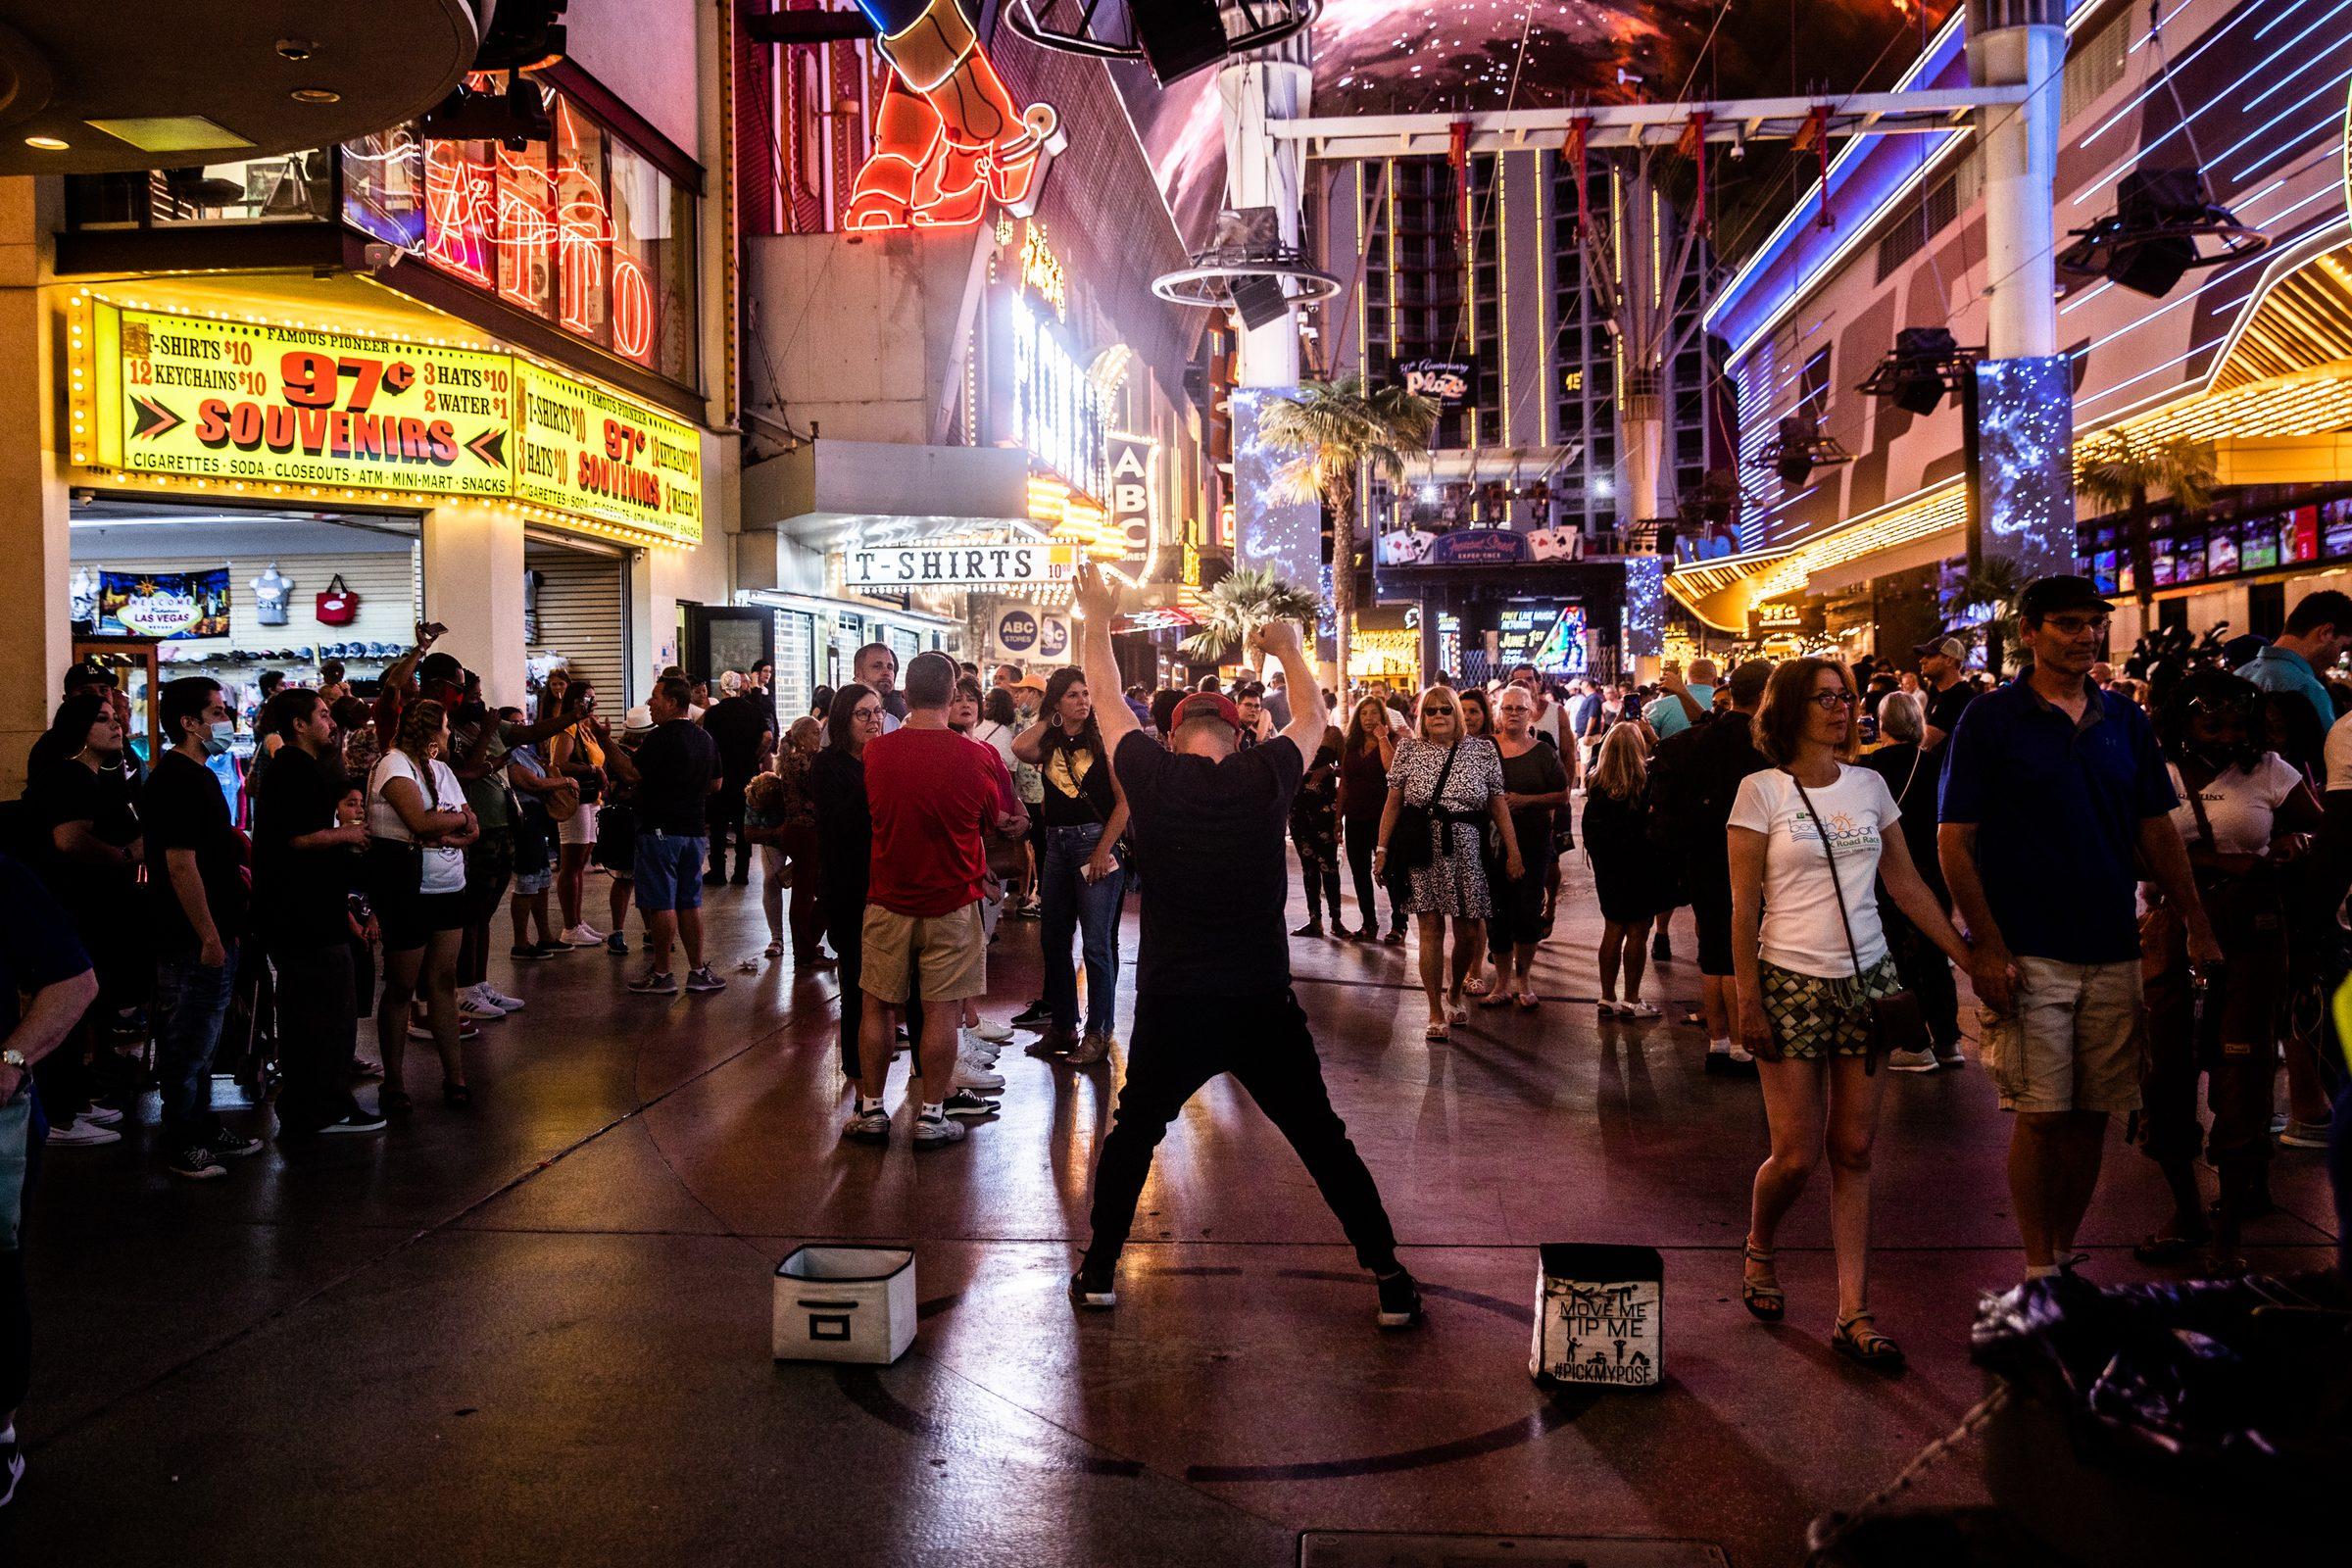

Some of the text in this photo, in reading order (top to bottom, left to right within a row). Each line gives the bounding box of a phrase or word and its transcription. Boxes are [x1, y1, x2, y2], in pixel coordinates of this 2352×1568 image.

[149, 334, 252, 366] T-SHIRTS $10
[267, 327, 390, 353] FAMOUS PIONEER
[130, 360, 267, 397] 12 KEYCHAINS $10
[424, 363, 509, 393] 3 HATS $10
[1406, 371, 1468, 398] Plaza
[424, 389, 509, 419] 2 WATER $1
[527, 392, 586, 444] T-SHIRTS $10
[586, 390, 648, 425] FAMOUS PIONEER
[196, 398, 460, 467] SOUVENIRS
[519, 436, 567, 486] 3 HATS $10
[651, 435, 660, 468] 12
[134, 453, 507, 493] CIGARETTES SODA CLOSEOUTS ATM MINI-MART SNACKS
[577, 451, 662, 512] SOUVENIRS
[520, 483, 565, 505] CIGARETTES
[665, 482, 671, 515] 2
[672, 488, 694, 516] WATER
[1112, 445, 1147, 548] ABC
[856, 550, 1032, 581] T-SHIRTS
[157, 613, 190, 622] VEGAS
[1003, 621, 1034, 633] ABC
[1788, 815, 1836, 832] beah
[1837, 839, 1861, 848] Road
[1560, 1301, 1646, 1318] MOVE ME
[1562, 1316, 1644, 1338] TIP ME
[1554, 1362, 1651, 1384] #PICKMYPOSE
